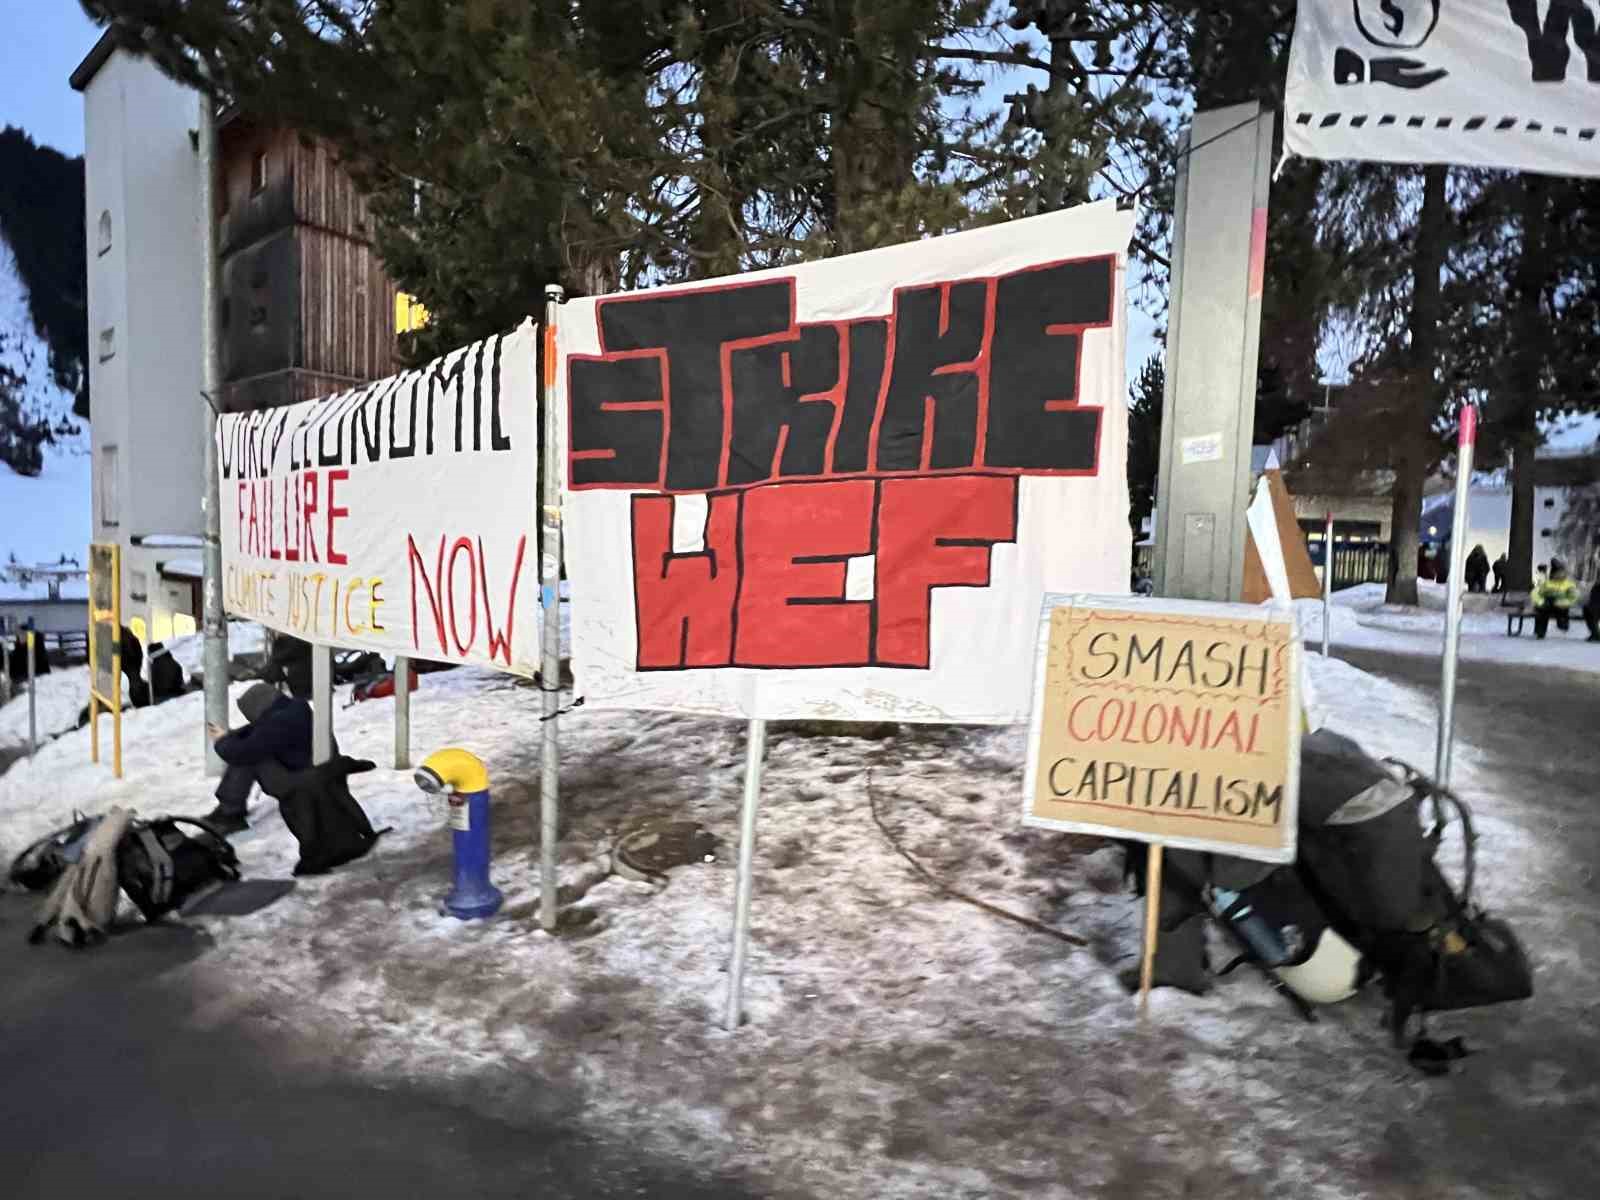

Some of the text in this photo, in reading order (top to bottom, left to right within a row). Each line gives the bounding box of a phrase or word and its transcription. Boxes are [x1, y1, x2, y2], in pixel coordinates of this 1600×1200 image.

[567, 253, 1117, 491] STRIKE
[238, 470, 349, 565] FAILURE
[287, 572, 385, 635] JUSTICE
[407, 533, 526, 666] NOW
[631, 475, 1019, 671] WEF
[1080, 631, 1269, 695] SMASH
[1067, 695, 1270, 756] COLONIAL
[1048, 757, 1284, 824] CAPITALISM
